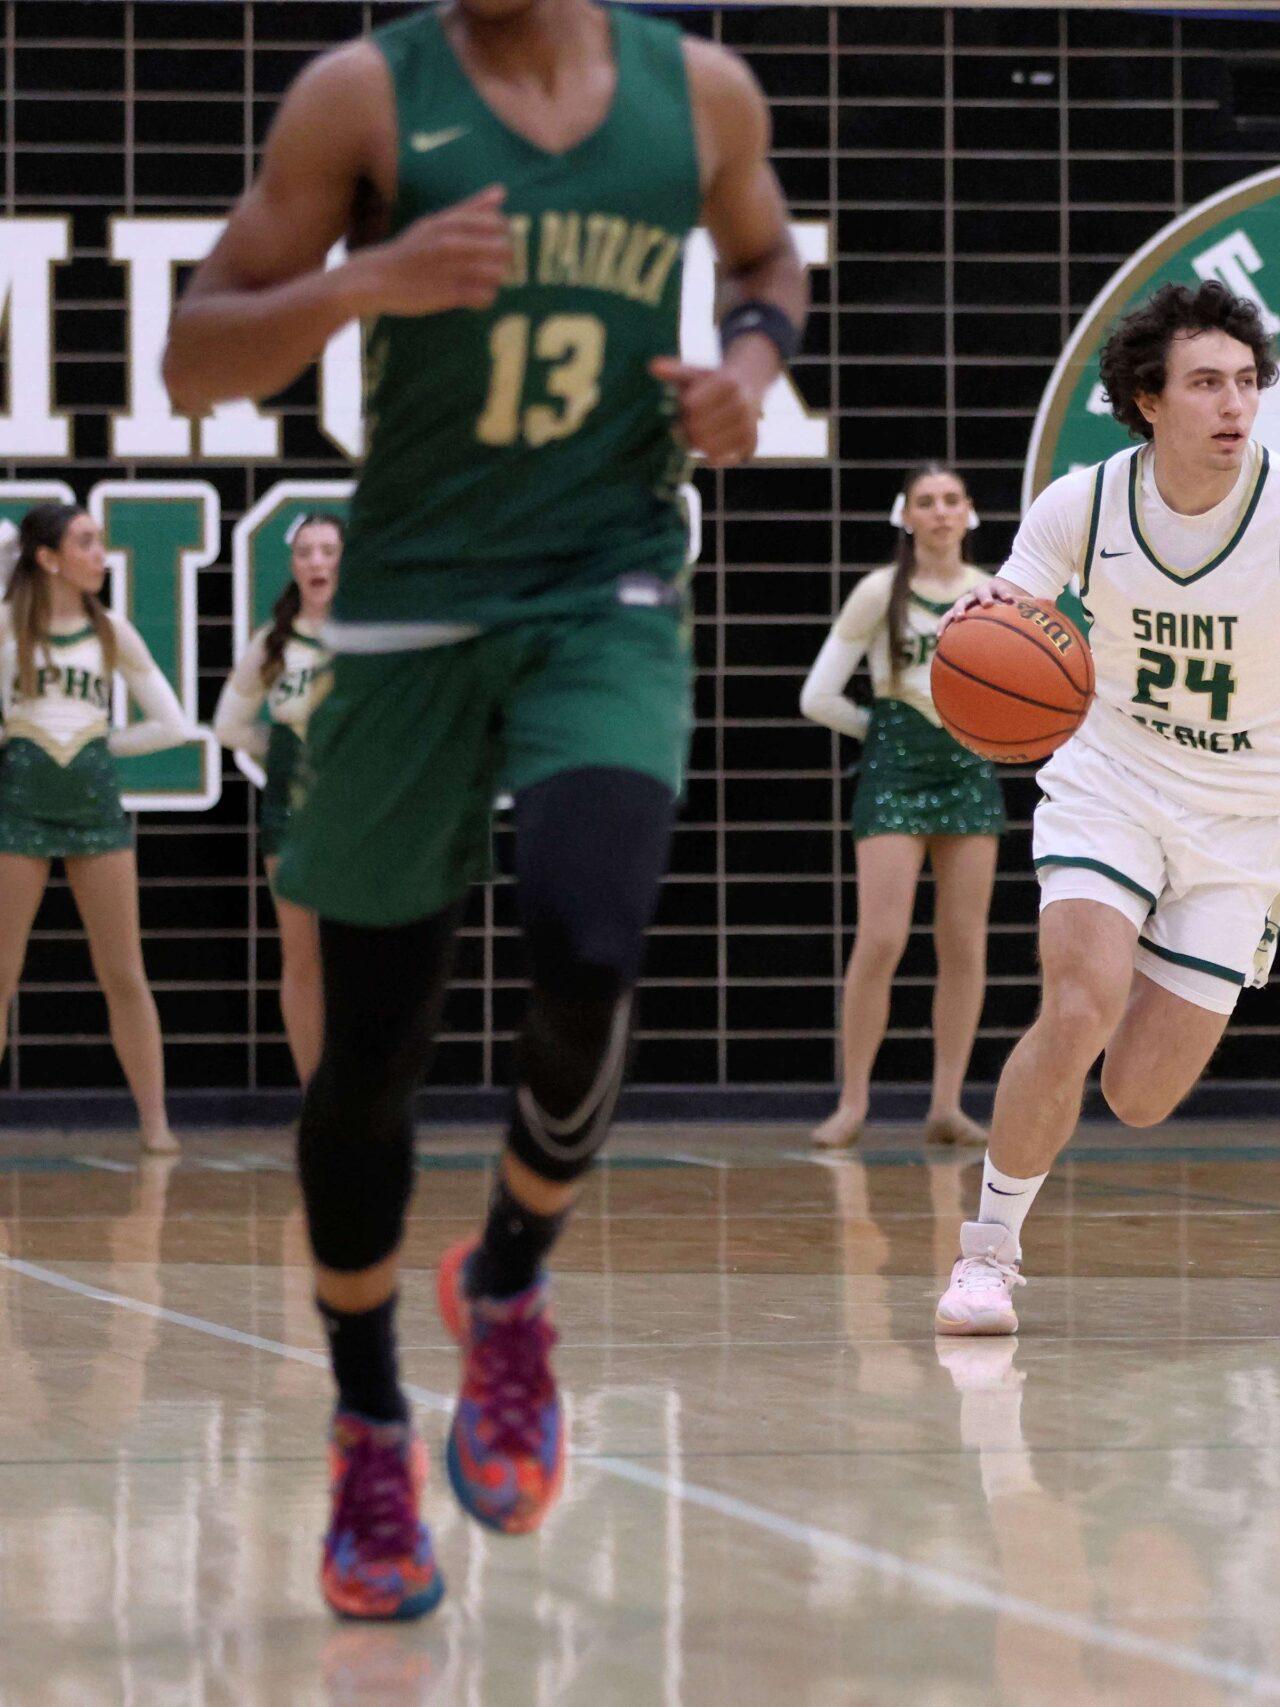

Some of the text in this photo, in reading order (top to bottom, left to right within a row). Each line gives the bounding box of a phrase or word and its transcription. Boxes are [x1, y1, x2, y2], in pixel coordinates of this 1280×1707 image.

[475, 311, 607, 449] 13
[1132, 608, 1238, 651] SAINT
[1131, 647, 1237, 722] 24
